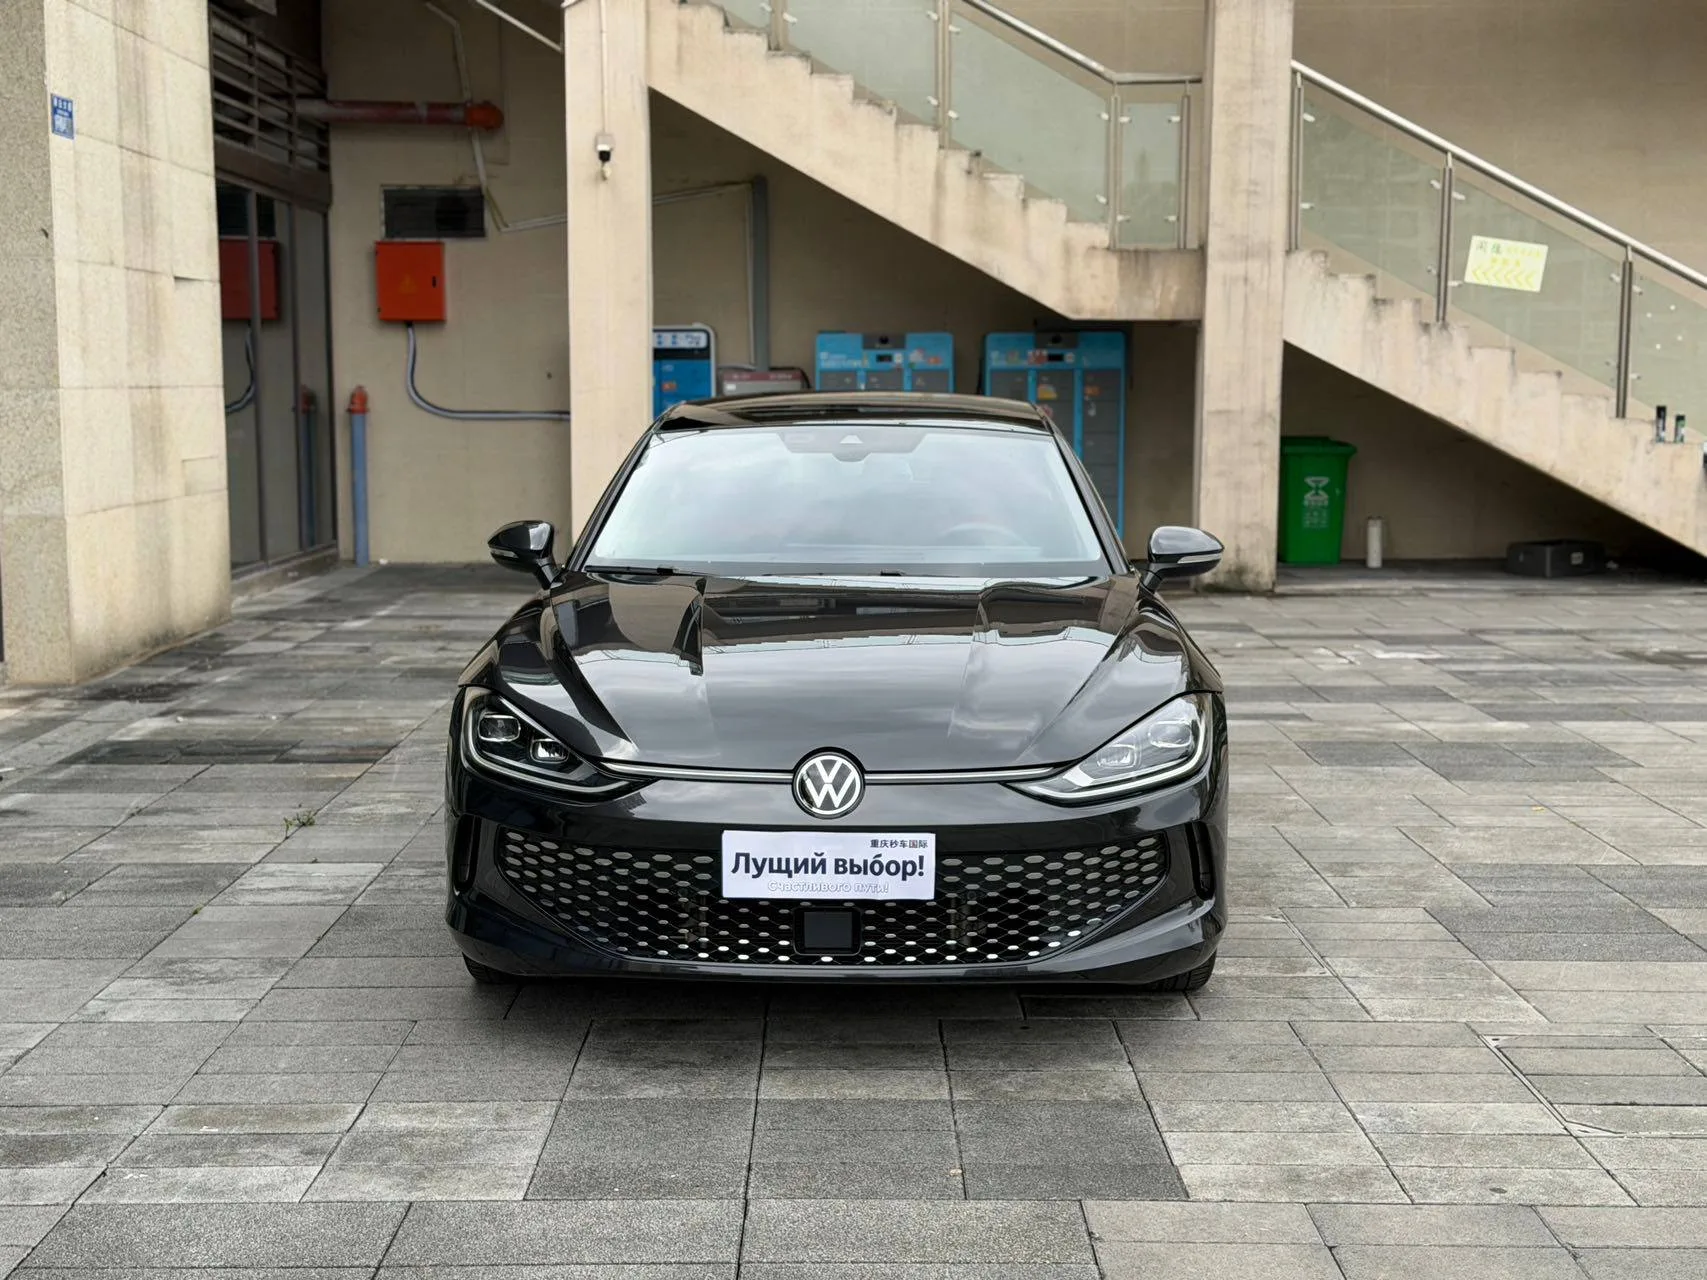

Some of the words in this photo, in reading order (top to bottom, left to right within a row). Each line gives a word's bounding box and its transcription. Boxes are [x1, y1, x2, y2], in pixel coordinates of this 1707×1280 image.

[799, 757, 858, 810] VW
[870, 839, 928, 849] 重庆秒车国际
[731, 852, 828, 879] Лущий
[834, 853, 925, 881] выбор!
[767, 881, 851, 893] Счастливого
[854, 882, 889, 894] пути!
